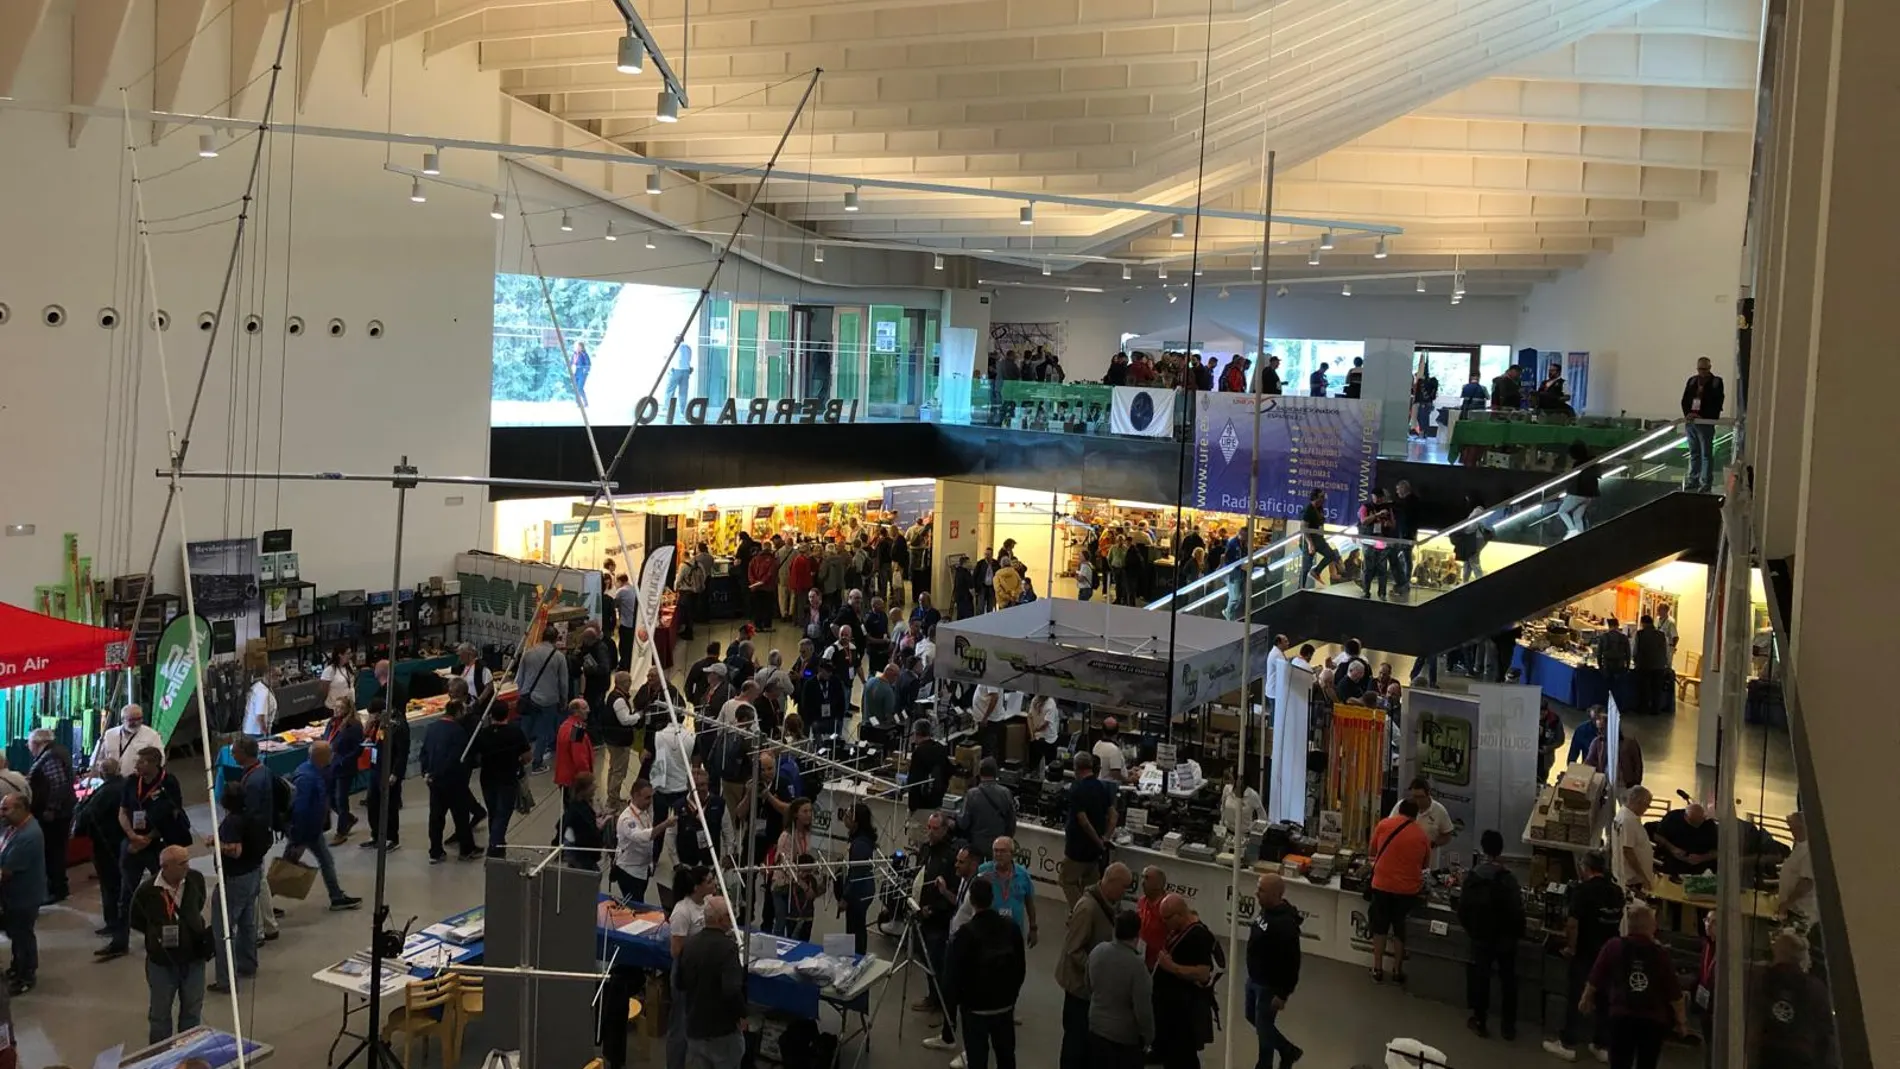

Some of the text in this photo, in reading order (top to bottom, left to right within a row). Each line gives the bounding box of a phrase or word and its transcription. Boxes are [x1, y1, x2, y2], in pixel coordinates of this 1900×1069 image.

[1298, 469, 1331, 478] DIPLOMAS
[1297, 480, 1349, 491] PUBLICACIONES
[1221, 494, 1338, 519] Radiaficionos
[22, 656, 50, 673] Air
[1165, 883, 1199, 898] ESU
